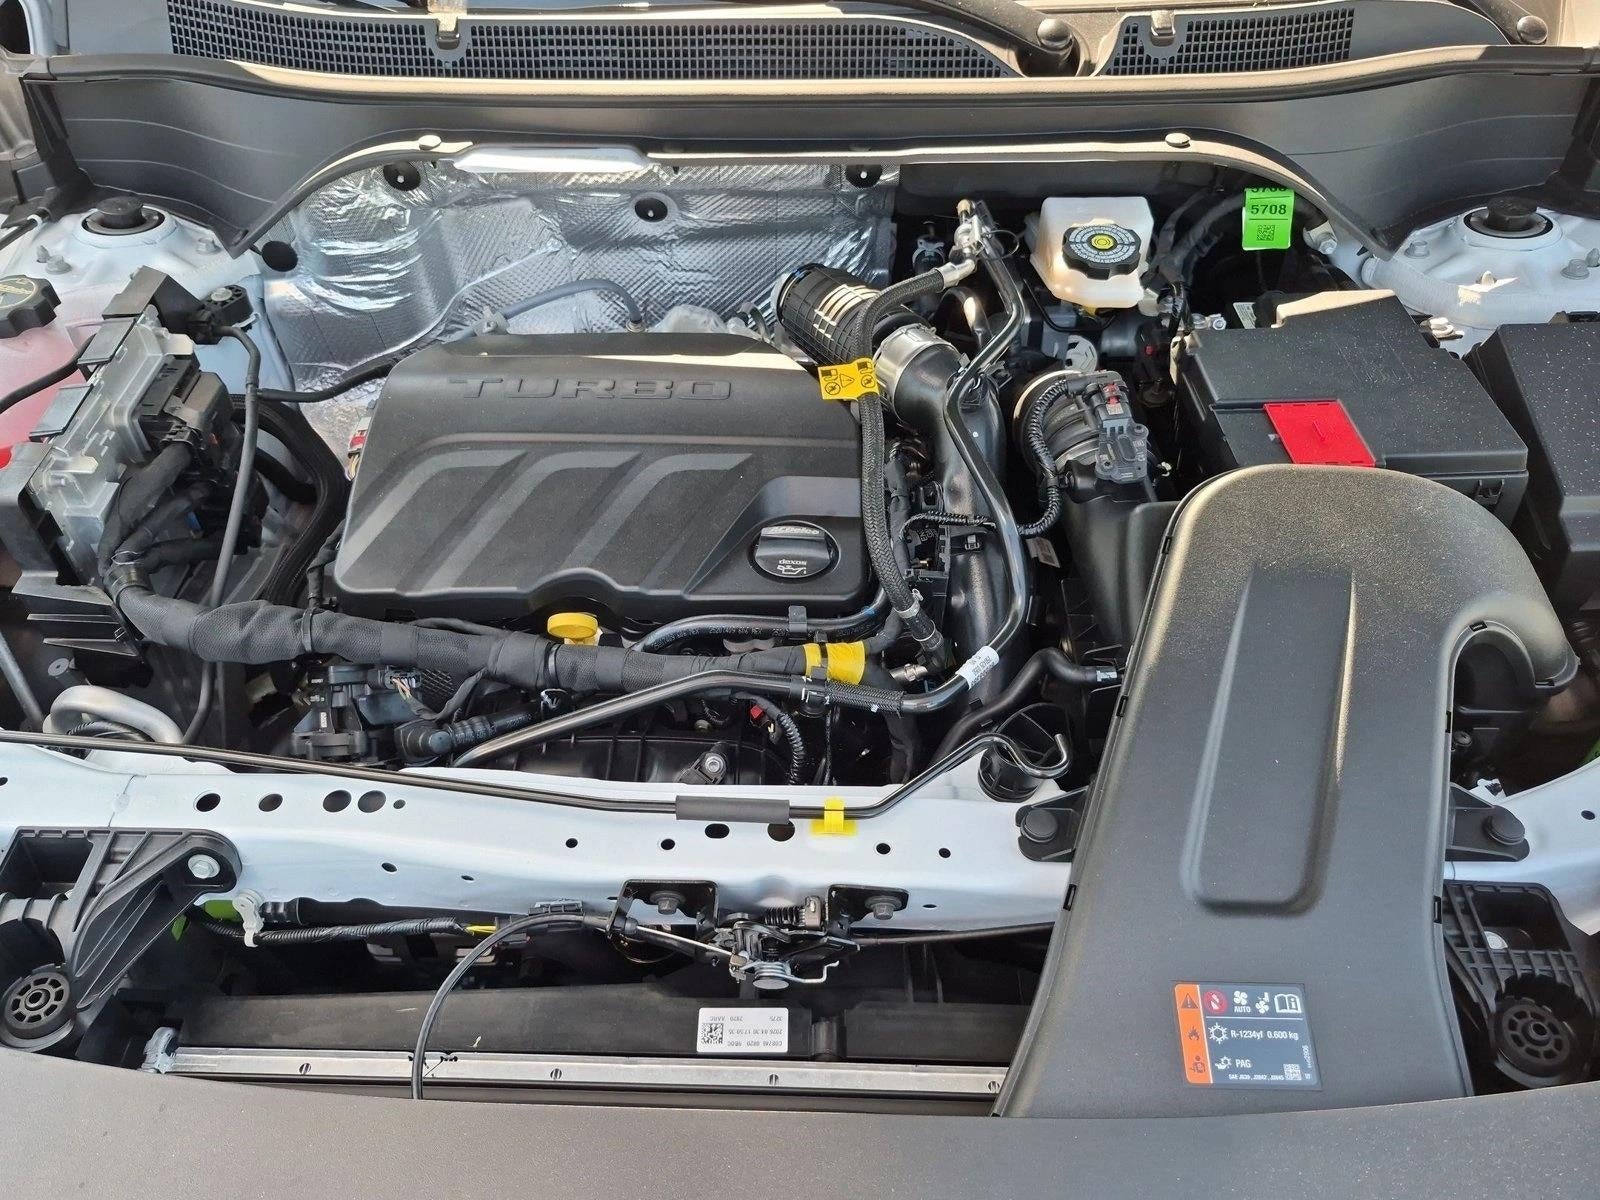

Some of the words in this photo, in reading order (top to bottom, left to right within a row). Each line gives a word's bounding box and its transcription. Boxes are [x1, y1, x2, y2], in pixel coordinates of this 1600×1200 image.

[1250, 204, 1287, 215] 5708
[449, 377, 732, 400] TURBO
[1230, 1029, 1264, 1040] R-1234yf
[1267, 1031, 1288, 1039] 0.600
[1288, 1031, 1299, 1041] kg
[1235, 1059, 1252, 1068] PAG
